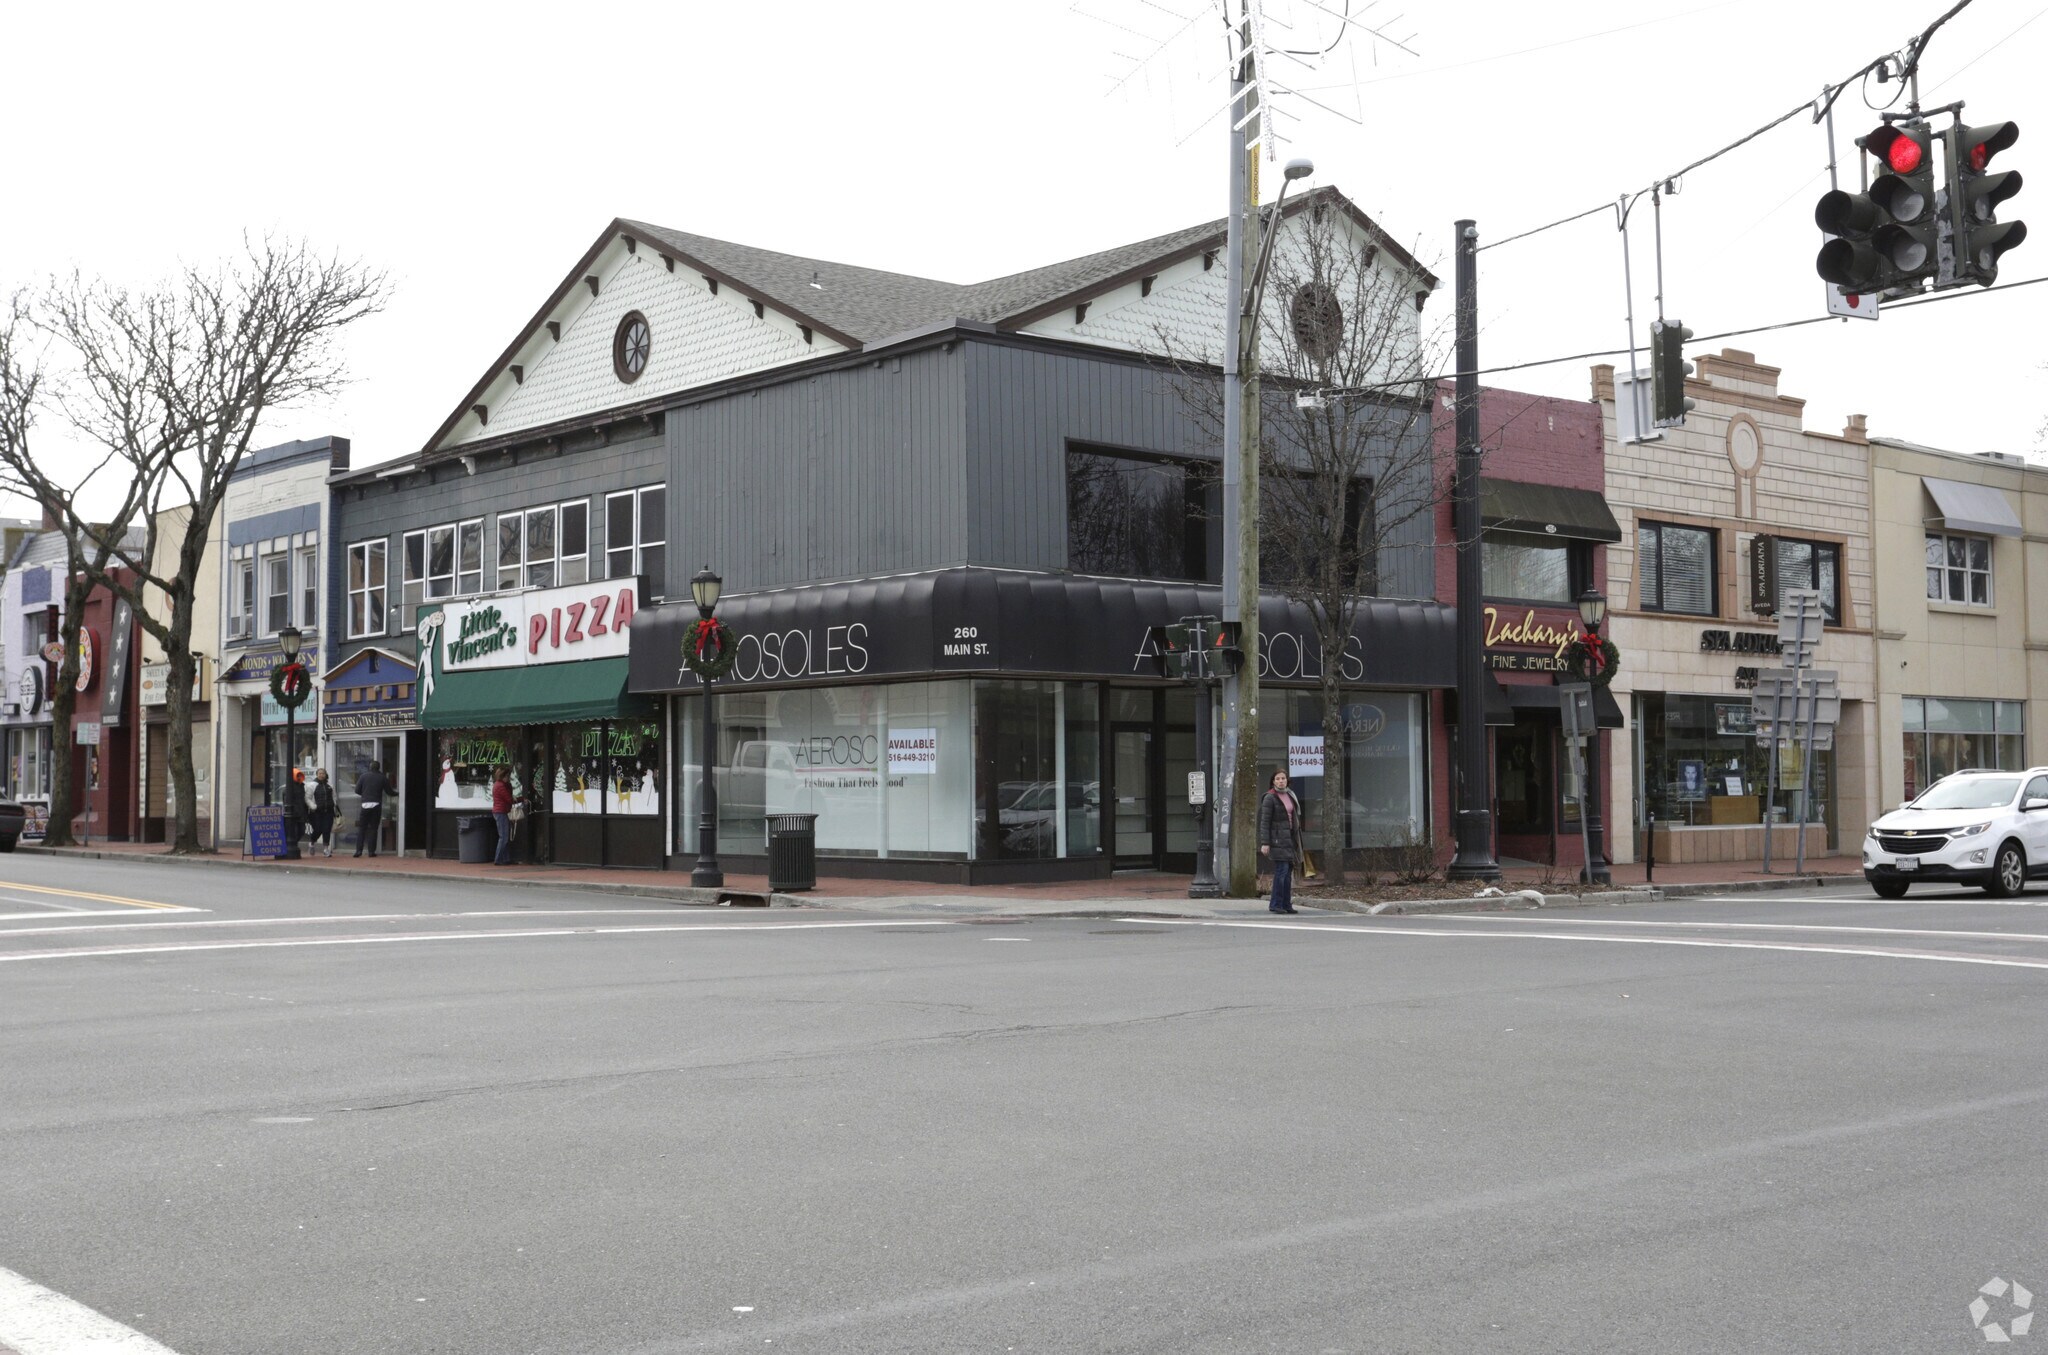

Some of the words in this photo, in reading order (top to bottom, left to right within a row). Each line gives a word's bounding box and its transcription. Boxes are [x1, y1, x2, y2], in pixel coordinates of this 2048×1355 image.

[1757, 541, 1766, 582] ADRIANA
[1758, 582, 1766, 597] SPA
[459, 605, 502, 640] Little
[529, 588, 634, 655] PIZZA
[953, 626, 978, 639] 260
[1484, 607, 1579, 659] Zachary's
[1700, 629, 1731, 652] SPA
[447, 622, 518, 666] Vincent's
[944, 643, 971, 656] MAIN
[973, 643, 990, 656] ST.
[1492, 655, 1517, 669] FINE
[1522, 656, 1569, 672] JEWELRY
[355, 713, 372, 728] COINS
[371, 713, 377, 727] &
[378, 712, 397, 726] ESTATE
[457, 740, 511, 765] PIZZA
[888, 739, 935, 750] AVAILABLE
[888, 752, 936, 762] 516-449-3210
[804, 777, 835, 788] Fashion
[837, 777, 857, 788] That
[858, 777, 879, 788] Feels
[886, 777, 904, 788] ood
[256, 839, 283, 847] SILVER
[259, 831, 279, 839] GOLD
